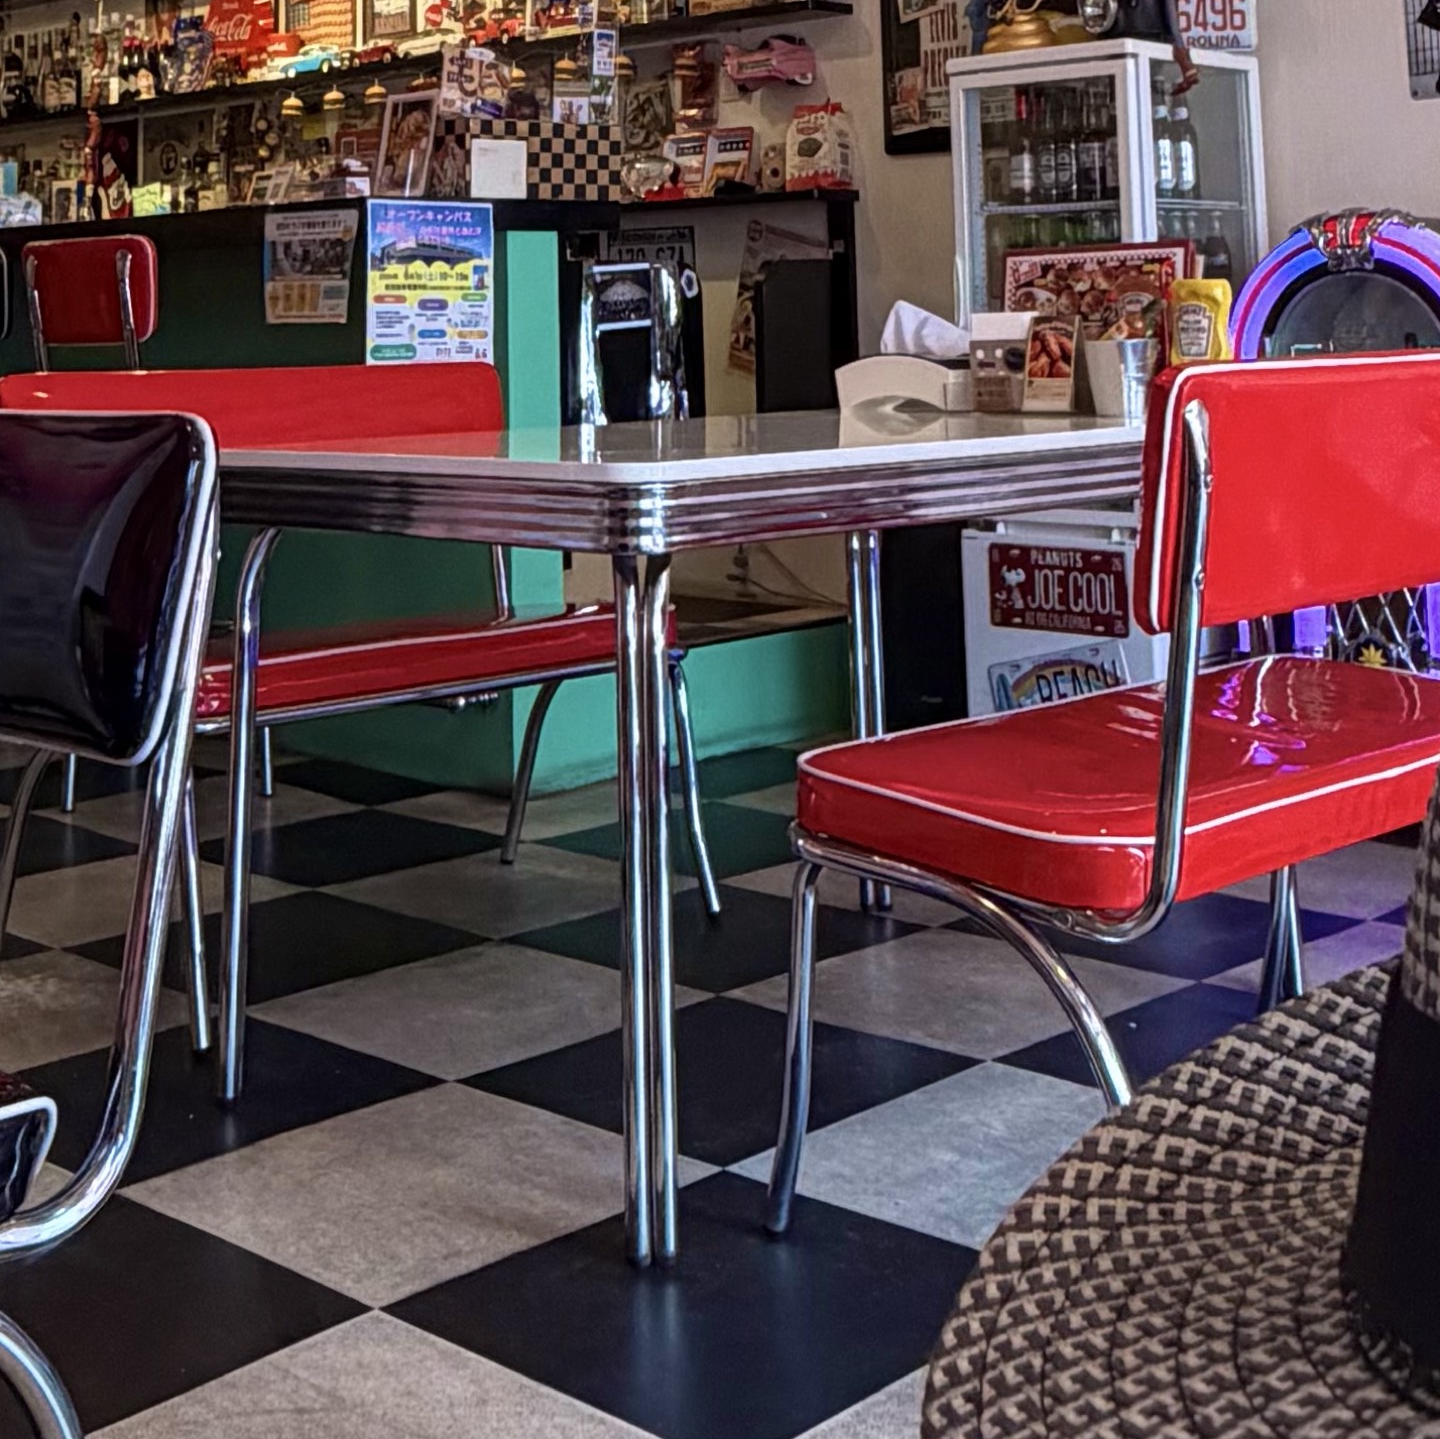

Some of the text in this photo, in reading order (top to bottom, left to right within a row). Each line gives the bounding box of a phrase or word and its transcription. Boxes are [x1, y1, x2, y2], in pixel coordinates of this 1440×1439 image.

[1029, 549, 1084, 569] PEANUTS
[1026, 568, 1124, 617] JOE COOL
